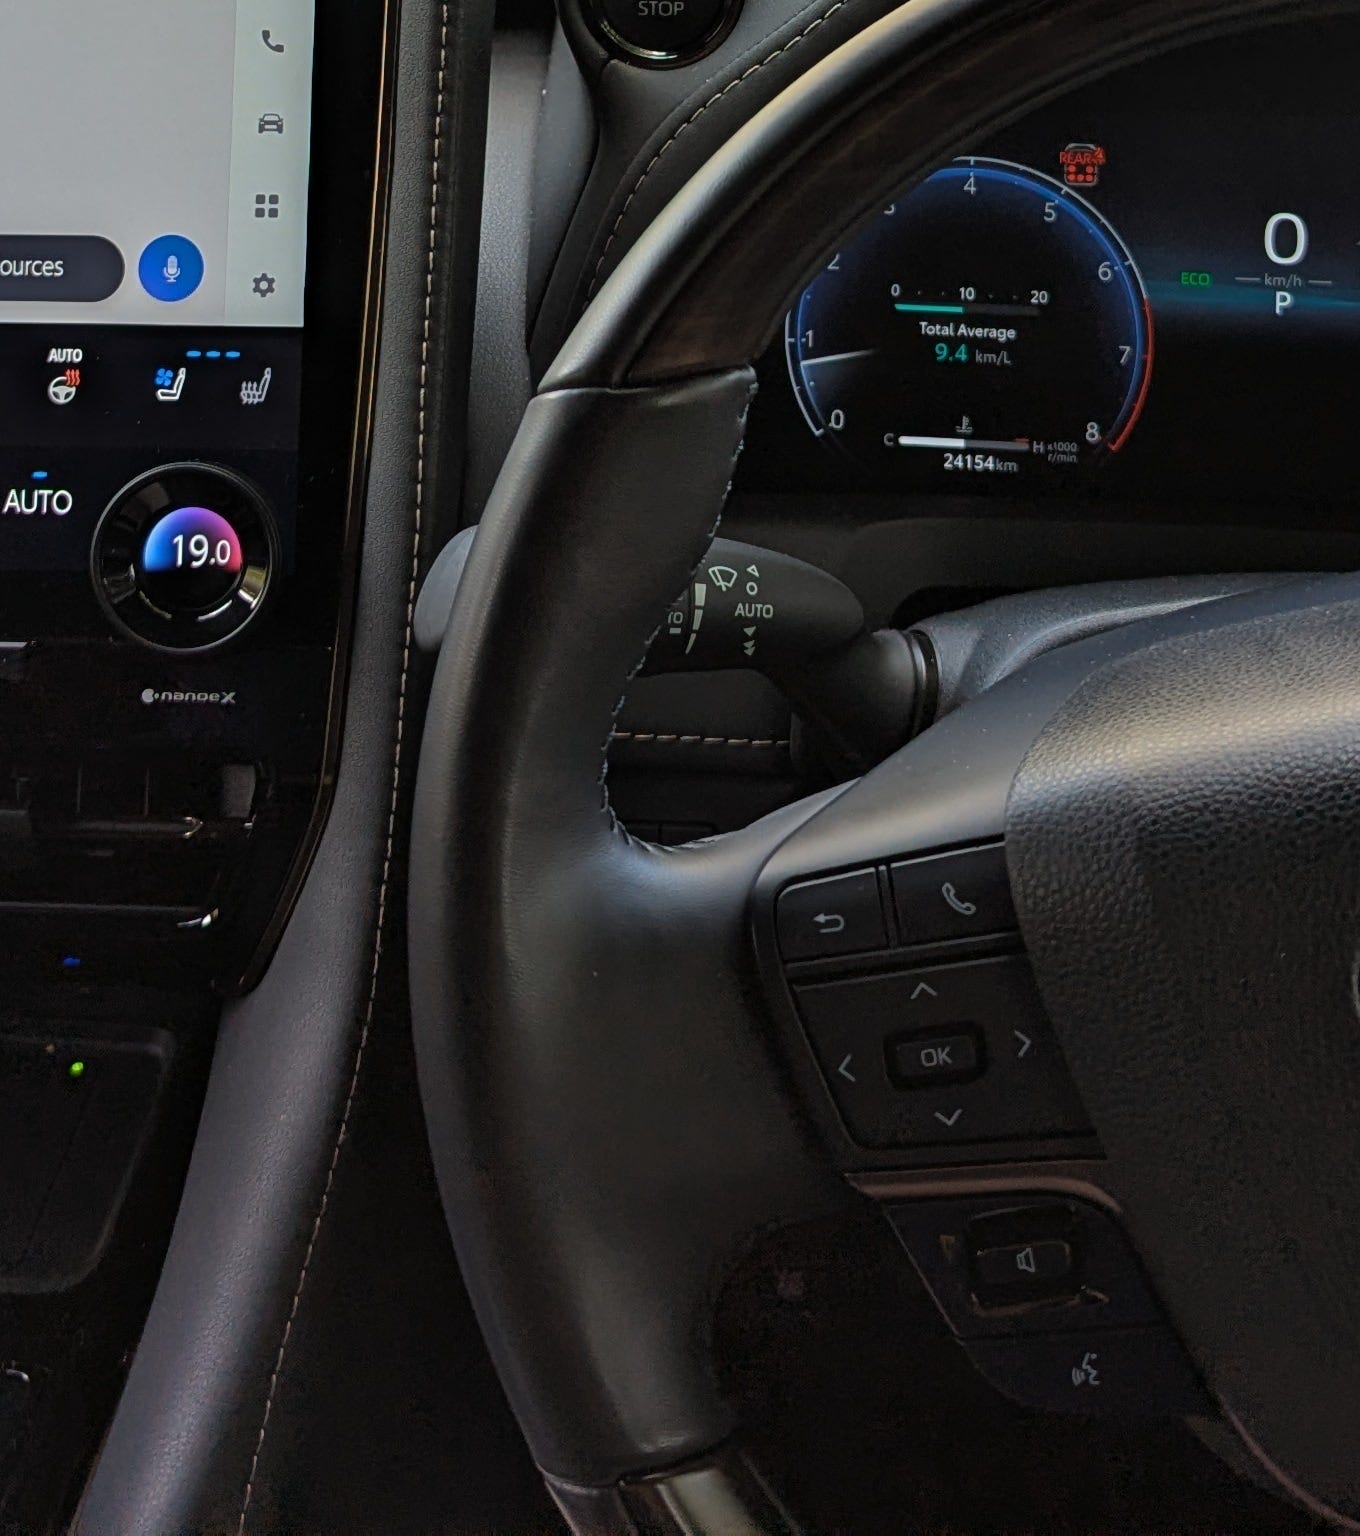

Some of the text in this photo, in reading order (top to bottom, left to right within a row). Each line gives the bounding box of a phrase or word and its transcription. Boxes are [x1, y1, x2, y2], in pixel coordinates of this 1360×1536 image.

[638, 0, 685, 16] STOP
[963, 176, 977, 195] 4
[1044, 202, 1057, 221] 5
[1263, 212, 1308, 265] 0
[1098, 261, 1112, 280] 6
[1180, 272, 1210, 286] ECO
[1263, 272, 1302, 288] km/h
[960, 287, 975, 300] 10
[1030, 290, 1049, 304] 20
[1274, 291, 1292, 315] P
[919, 321, 1017, 343] Total Average
[48, 348, 83, 363] AUTO
[935, 343, 969, 361] 9.4
[1119, 345, 1131, 364] 7
[830, 409, 845, 429] 0
[1085, 422, 1101, 442] 8
[2, 490, 72, 515] AUTO
[173, 534, 232, 567] 19.0
[735, 603, 774, 618] AUTO
[920, 1046, 953, 1067] OK
